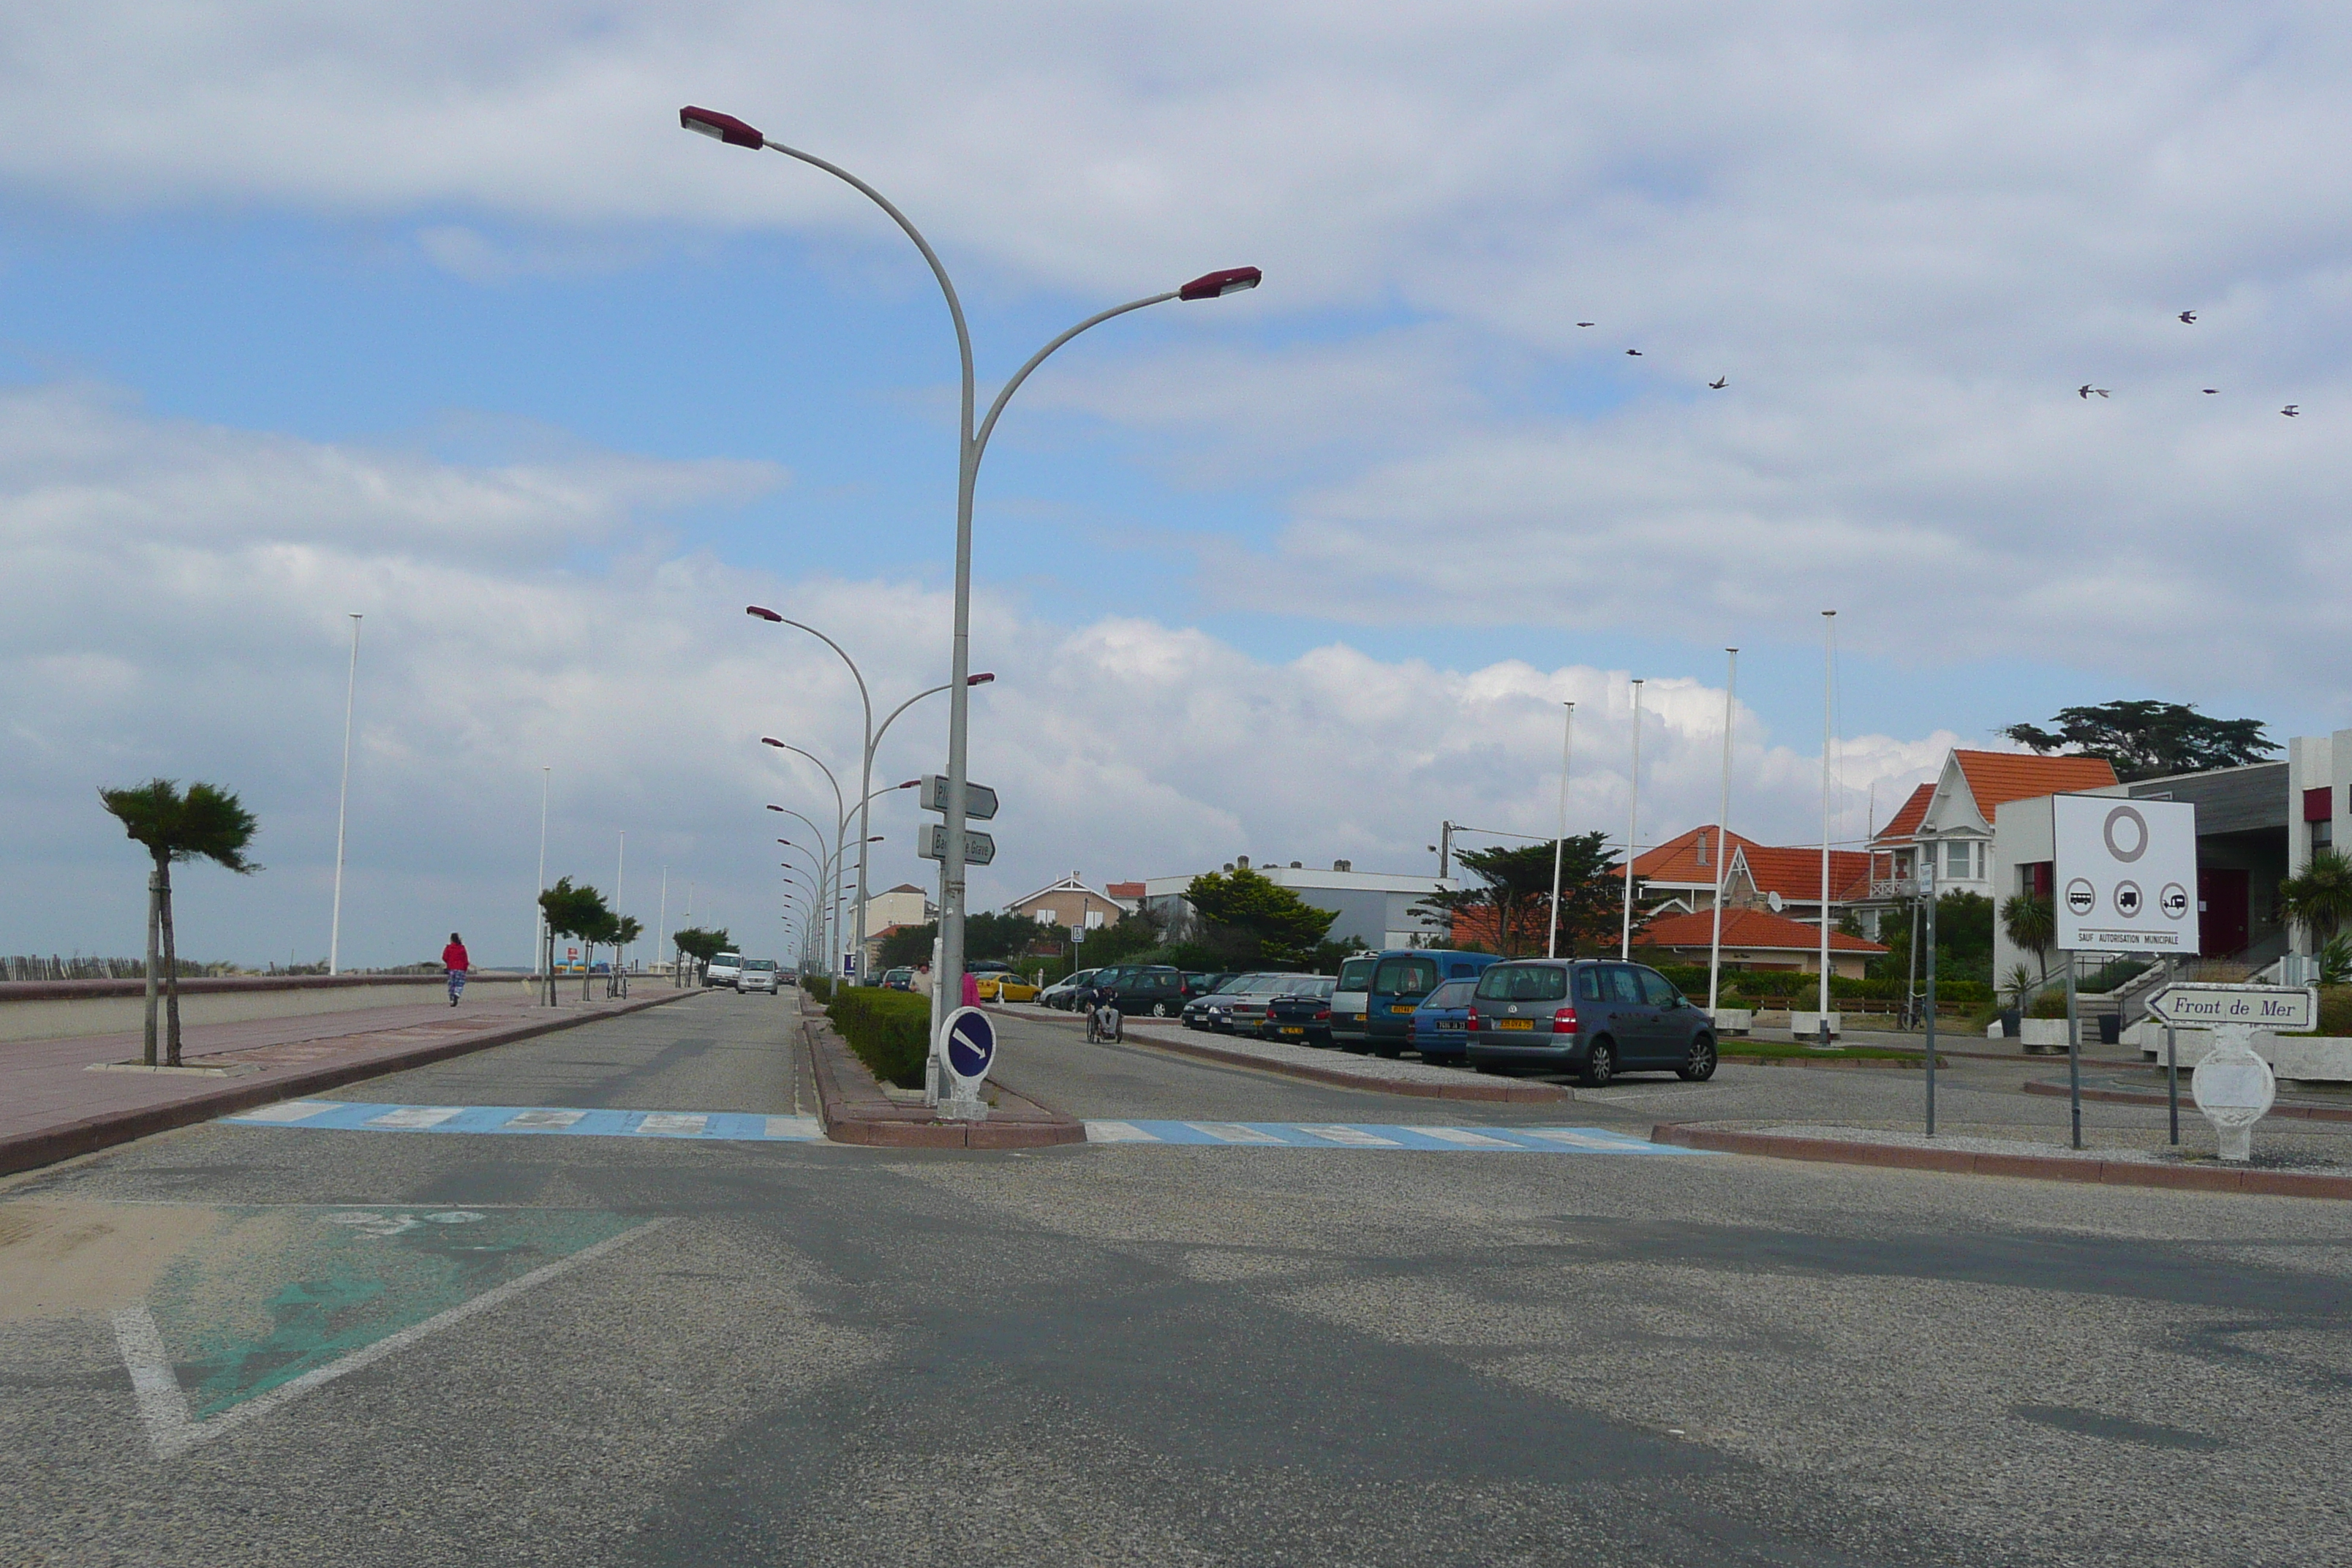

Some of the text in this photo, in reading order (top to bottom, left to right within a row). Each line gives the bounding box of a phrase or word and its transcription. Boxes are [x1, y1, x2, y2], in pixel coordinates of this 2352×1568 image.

[971, 840, 989, 856] Grave
[2078, 933, 2179, 945] SAUF AUTORISATION MUNICIPALE
[2174, 998, 2296, 1017] Front de Mer
